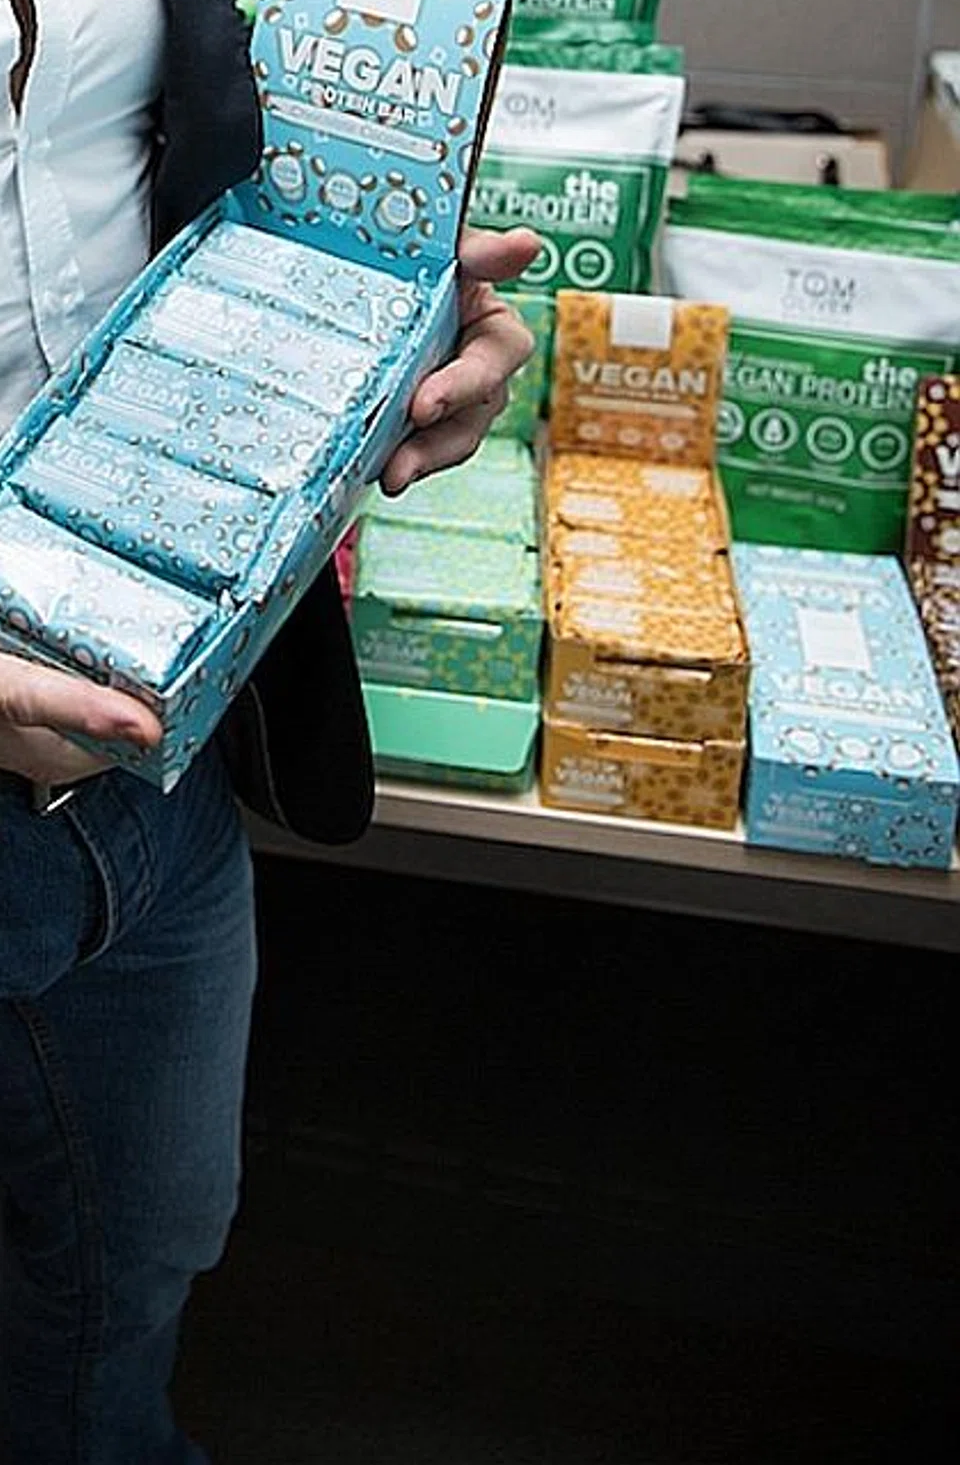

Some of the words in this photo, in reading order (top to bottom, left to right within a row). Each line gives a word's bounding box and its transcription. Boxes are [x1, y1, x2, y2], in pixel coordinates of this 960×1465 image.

[277, 27, 462, 116] VEGAN
[300, 81, 376, 114] PROTEIN
[563, 170, 620, 201] the
[505, 189, 620, 226] PROTEIN
[784, 268, 856, 298] TOM
[572, 360, 707, 395] VEGAN
[722, 352, 794, 396] EGAN
[799, 374, 916, 411] PROTEIN
[862, 357, 920, 389] the
